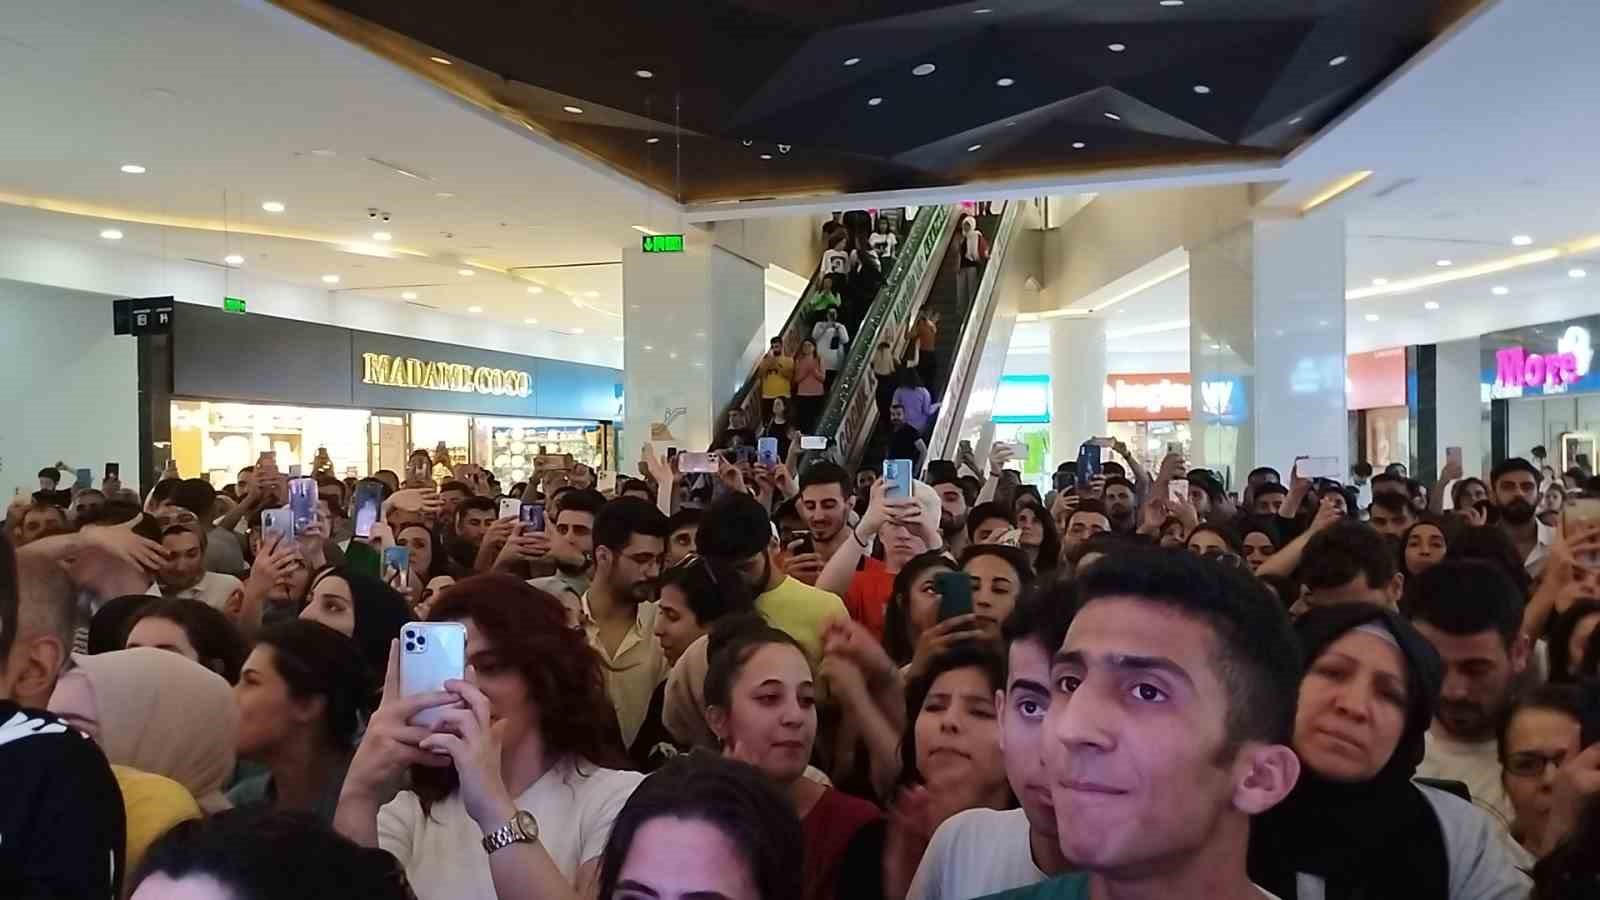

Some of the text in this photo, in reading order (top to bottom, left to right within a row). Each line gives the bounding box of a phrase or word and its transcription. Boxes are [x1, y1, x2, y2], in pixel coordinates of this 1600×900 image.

[362, 351, 533, 397] MADAME COCO
[1496, 346, 1579, 389] More
